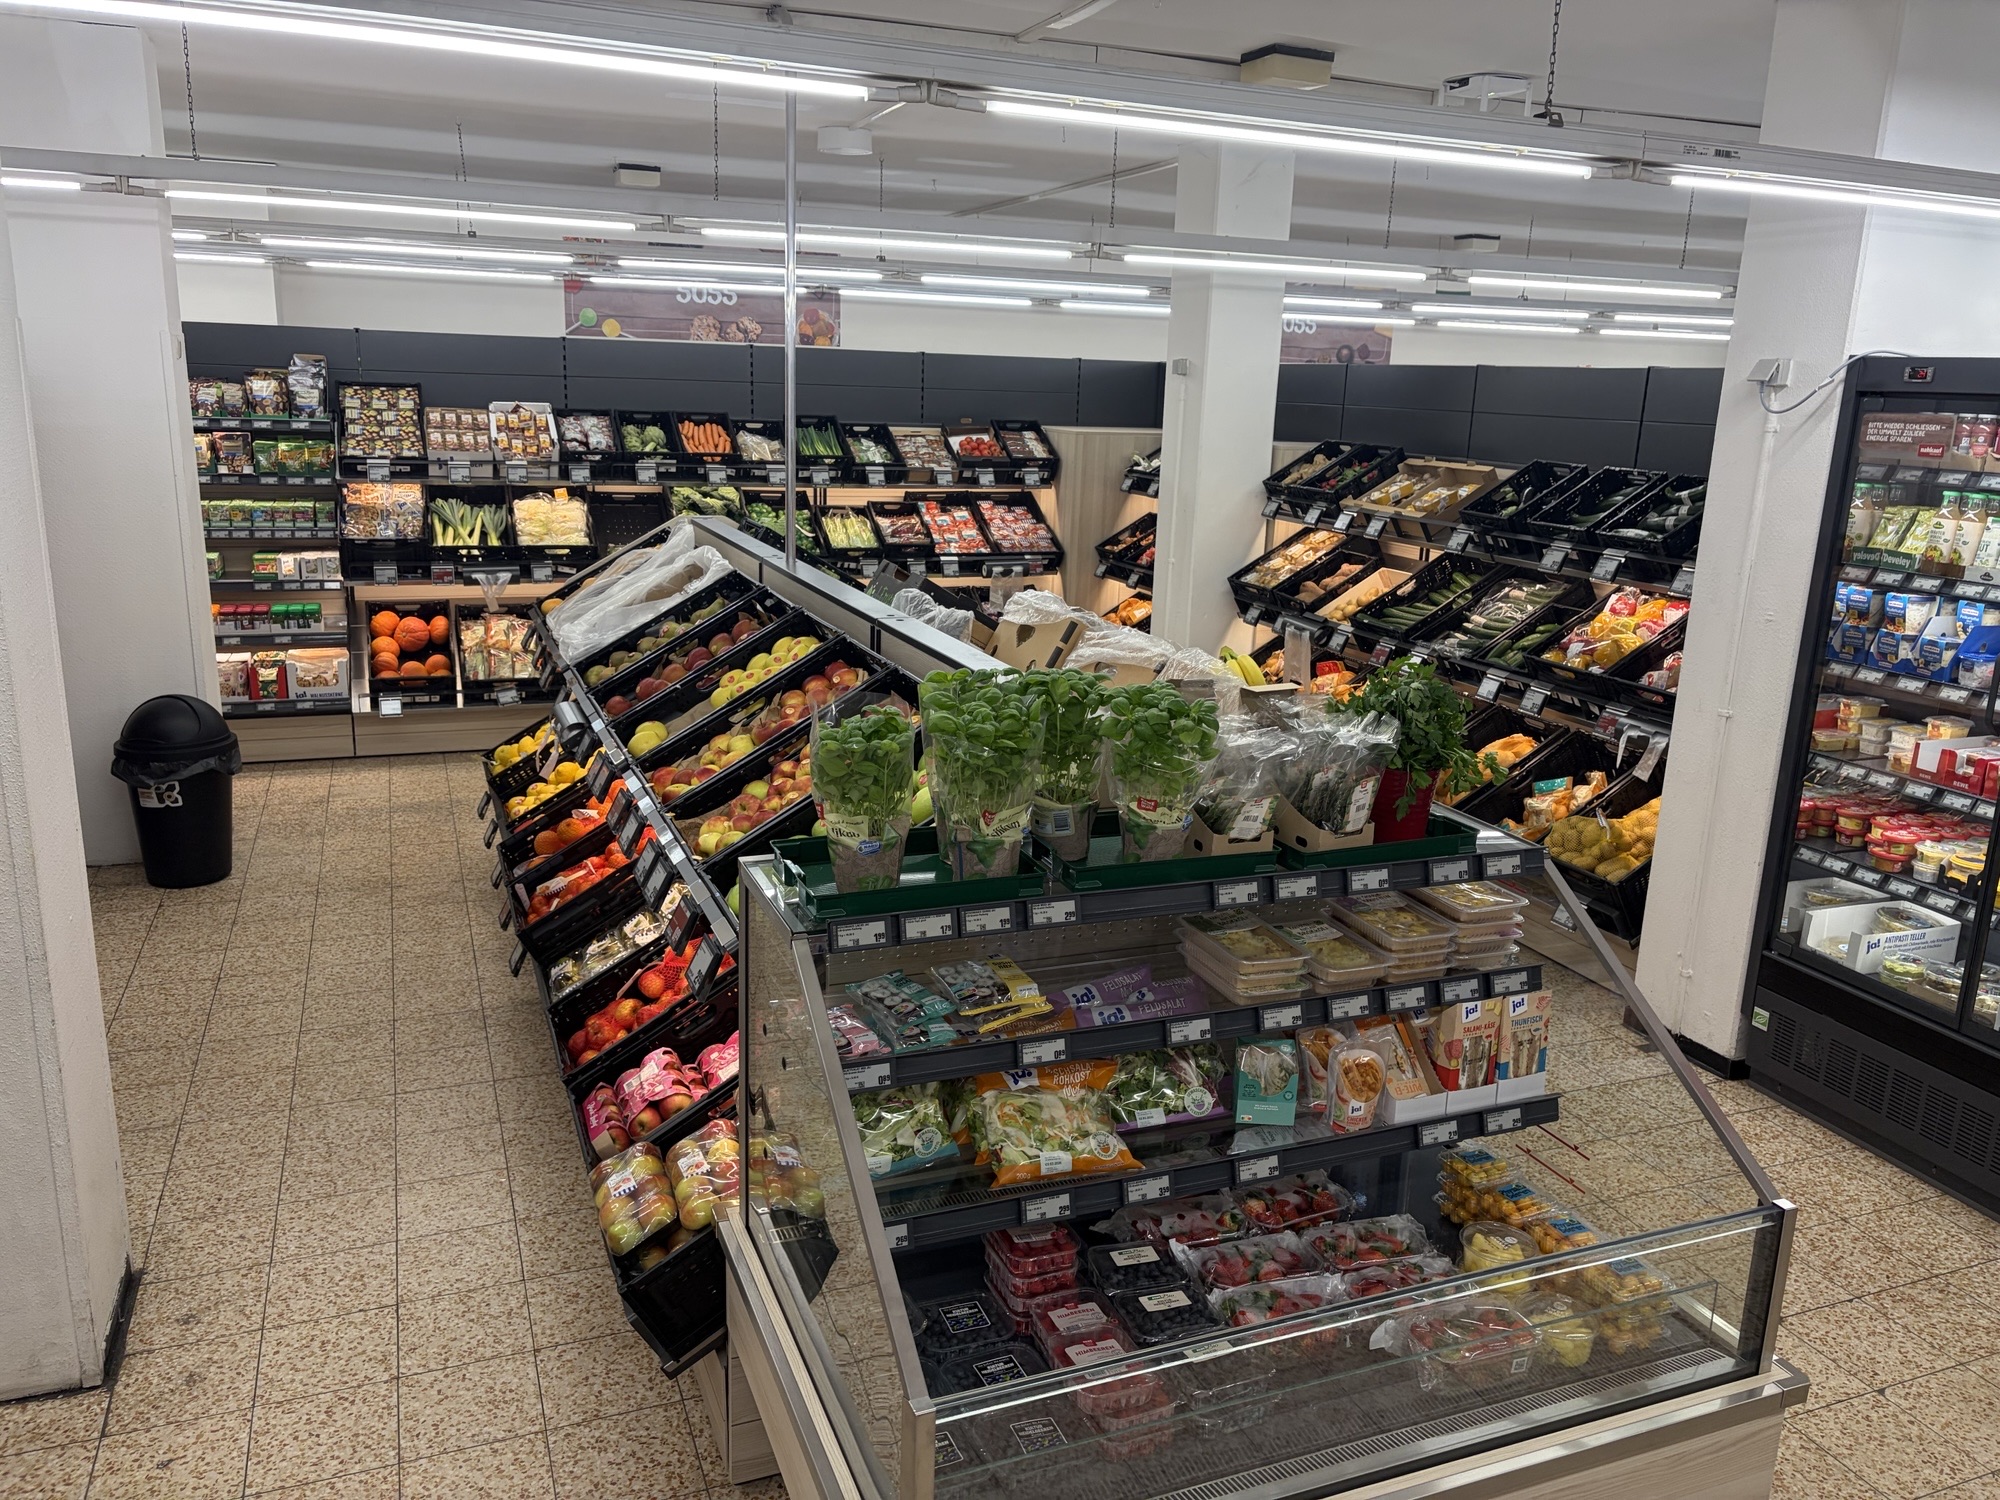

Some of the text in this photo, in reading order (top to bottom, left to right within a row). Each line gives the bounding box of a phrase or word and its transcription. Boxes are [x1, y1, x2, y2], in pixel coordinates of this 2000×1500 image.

[1884, 422, 1904, 430] WIEDER
[1906, 423, 1940, 431] SCHLIESSEN
[1883, 552, 1912, 567] Develey
[1953, 780, 1969, 789] REWE
[1884, 932, 1926, 943] ANTIPASTI TELLER
[1866, 938, 1880, 954] ja!
[1102, 972, 1142, 992] FELDSALAT
[1072, 986, 1095, 1010] ja!
[1138, 998, 1186, 1014] FELDSALAT
[1465, 1004, 1478, 1020] ja!
[1512, 998, 1525, 1014] ja!
[1098, 1008, 1125, 1026] ja!
[1511, 1014, 1543, 1027] THUNFISCH
[1463, 1021, 1496, 1034] SALAMI-KÄSE
[1054, 1071, 1090, 1086] ROHKOST
[1062, 1083, 1081, 1099] Mix
[1395, 1083, 1423, 1095] PUTE-EI
[1350, 1105, 1362, 1114] ja!
[1056, 1308, 1095, 1319] HIMBEEREN
[1075, 1345, 1115, 1356] HIMBEEREN
